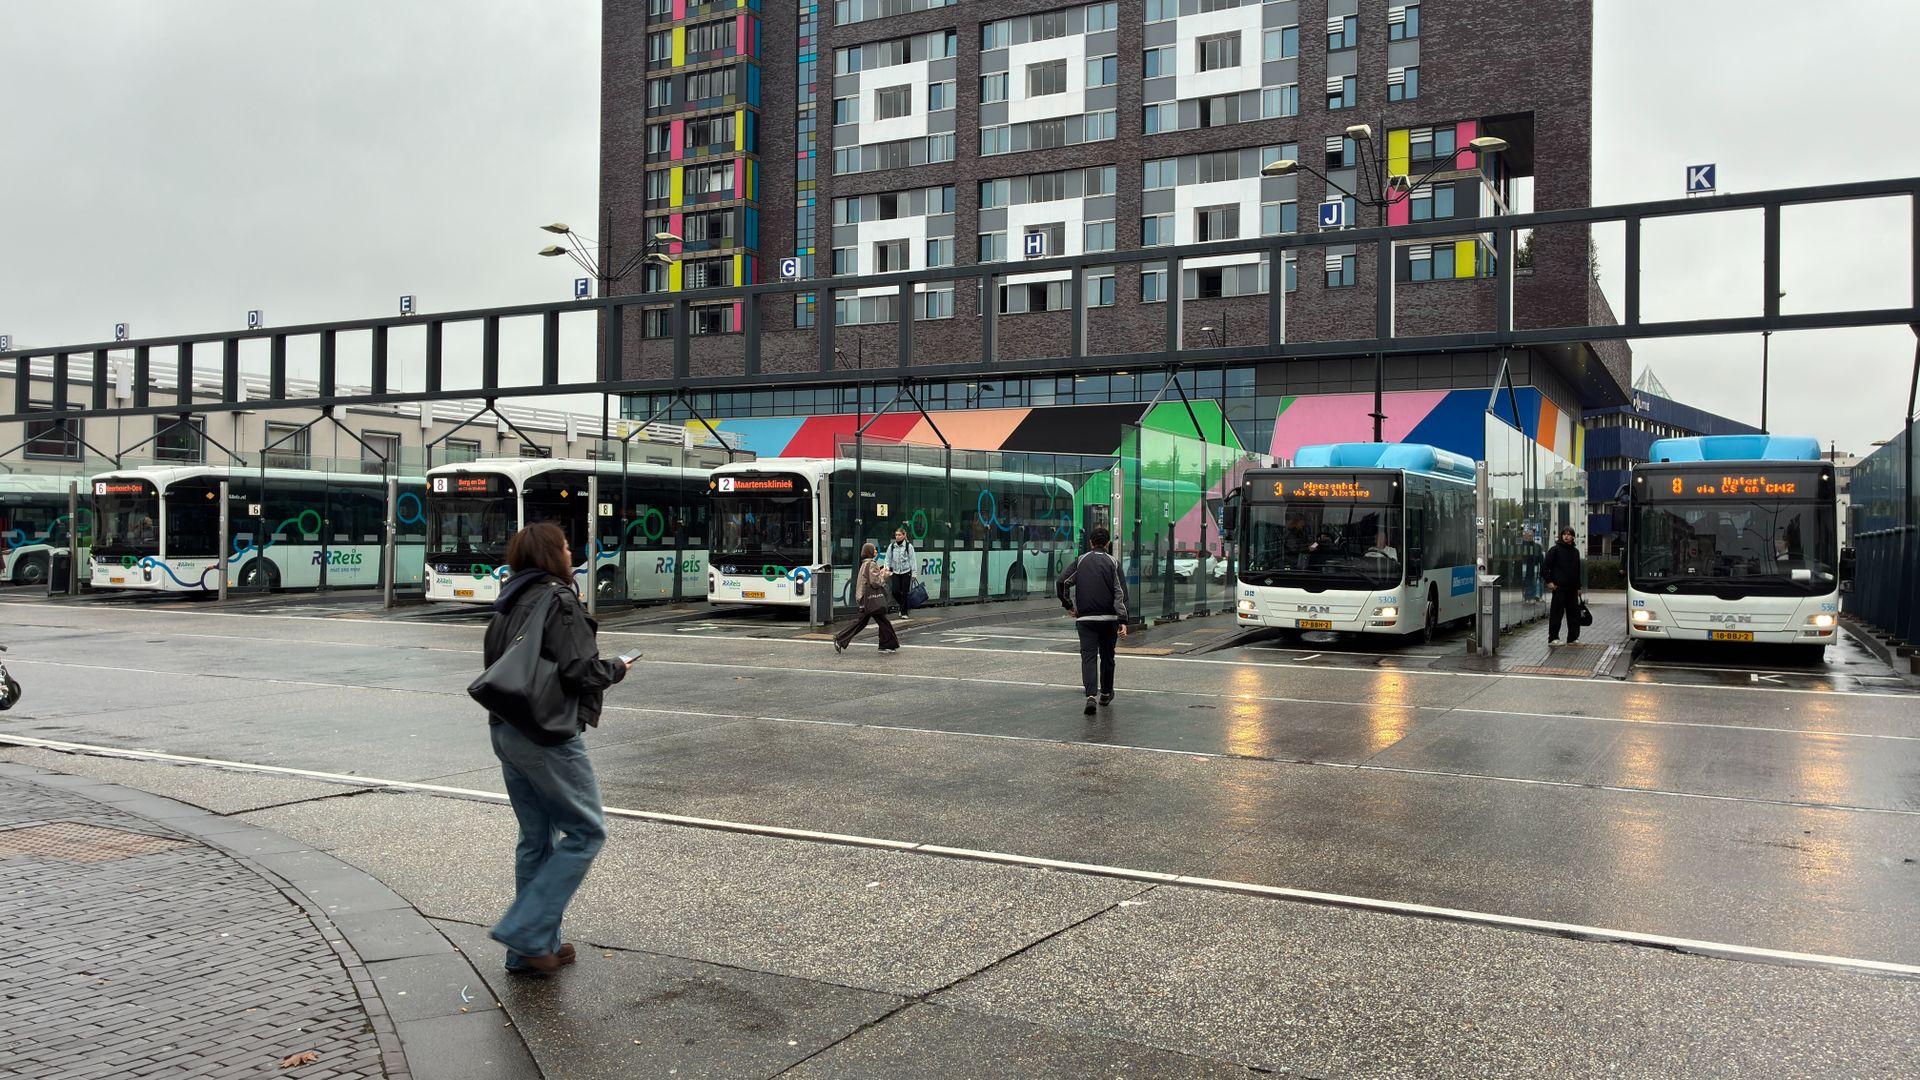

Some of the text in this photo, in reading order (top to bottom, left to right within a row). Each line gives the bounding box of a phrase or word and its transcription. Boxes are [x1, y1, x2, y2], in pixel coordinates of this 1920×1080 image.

[1689, 166, 1712, 190] K
[1324, 204, 1338, 225] J
[1027, 235, 1040, 254] H
[782, 259, 795, 277] G
[577, 280, 586, 295] F
[401, 297, 410, 311] E
[249, 312, 257, 325] D
[117, 324, 124, 337] C
[0, 336, 7, 348] B
[437, 479, 444, 491] 8
[722, 478, 730, 491] 2
[733, 480, 793, 489] Maartenskliniek
[1672, 477, 1682, 494] 8
[1723, 476, 1766, 486] Hatert
[98, 483, 104, 494] 6
[1273, 481, 1283, 497] 3
[1696, 484, 1715, 494] via
[1721, 484, 1738, 493] CS
[1744, 485, 1760, 493] en
[253, 505, 259, 515] 6
[603, 504, 609, 515] 8
[879, 504, 886, 516] 2
[655, 554, 701, 574] RReis
[920, 558, 957, 576] RRRs
[1378, 596, 1398, 604] 5308
[1296, 604, 1331, 614] MAN
[1709, 614, 1752, 624] MAN
[1715, 632, 1750, 640] 18-BBJ-2
